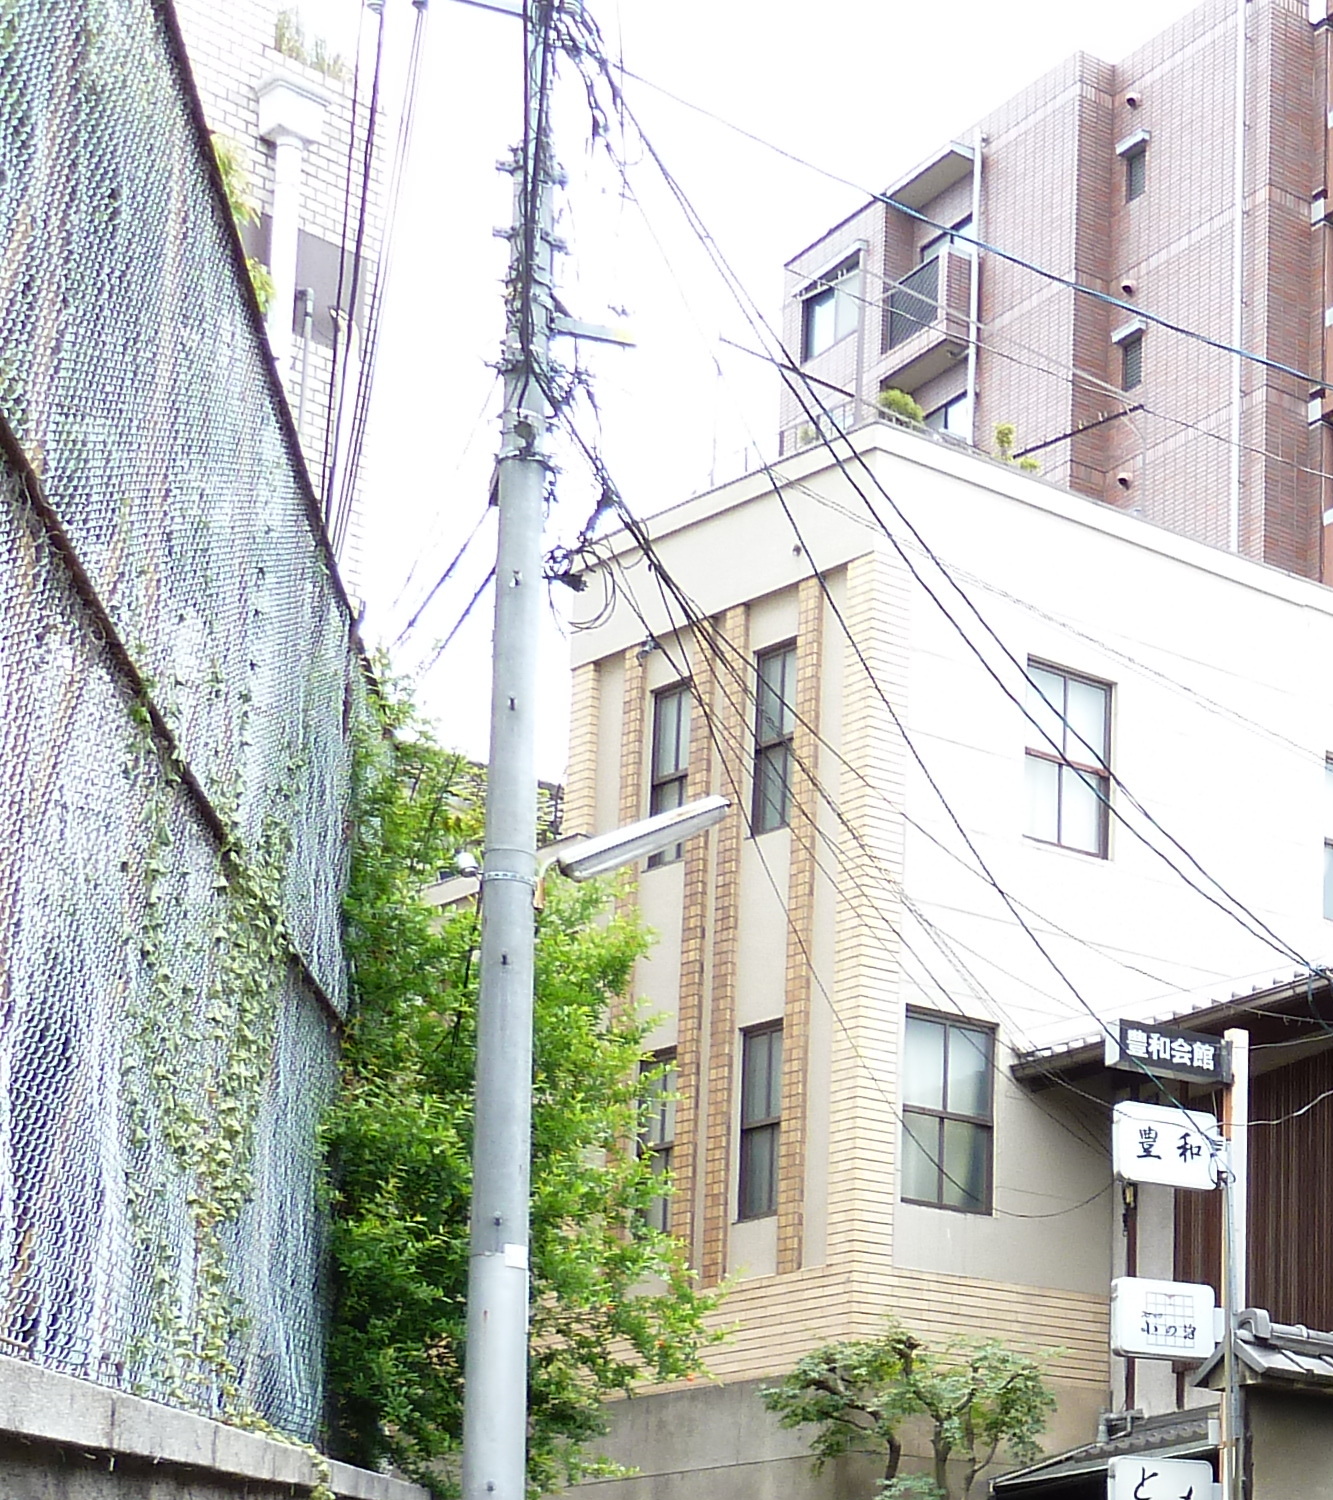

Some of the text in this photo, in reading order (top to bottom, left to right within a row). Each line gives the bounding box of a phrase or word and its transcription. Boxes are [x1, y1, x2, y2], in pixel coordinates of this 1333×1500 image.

[1126, 1029, 1215, 1071] 豊和会館
[1136, 1126, 1202, 1163] 豊和
